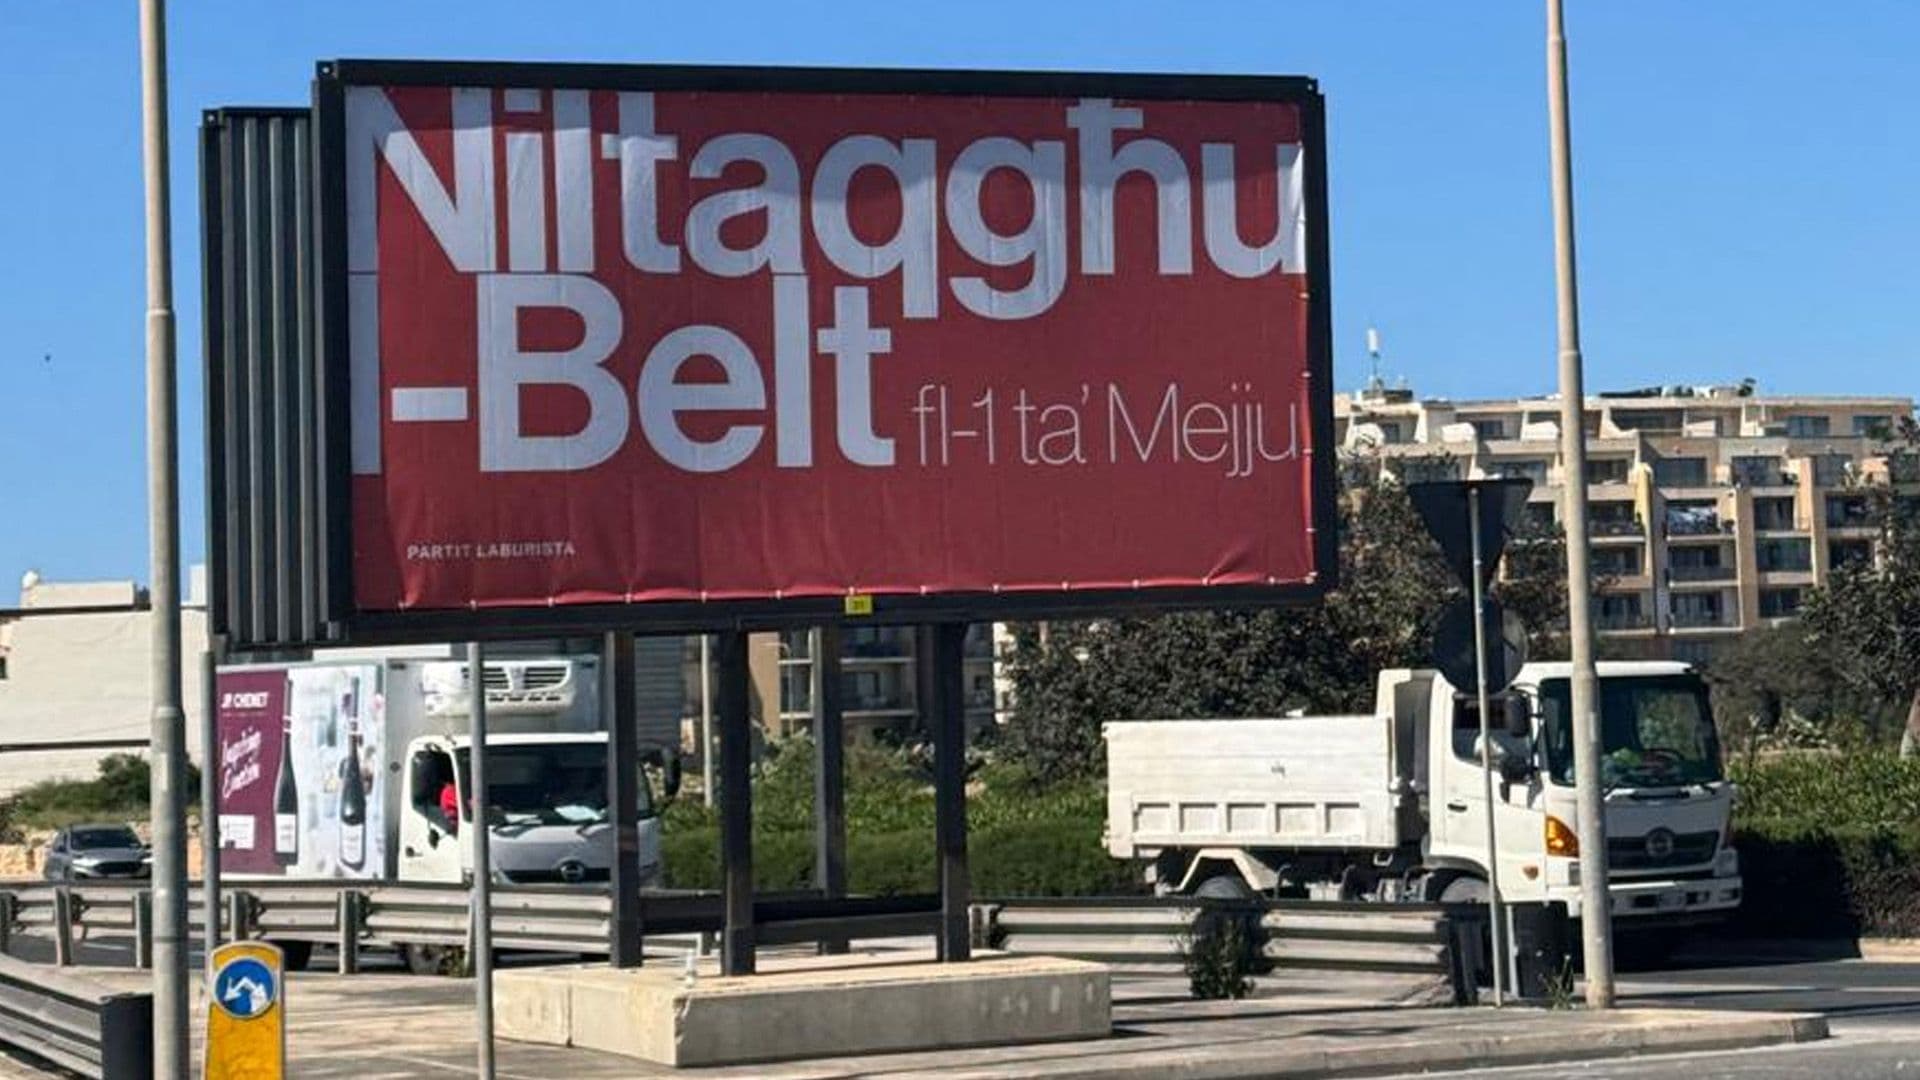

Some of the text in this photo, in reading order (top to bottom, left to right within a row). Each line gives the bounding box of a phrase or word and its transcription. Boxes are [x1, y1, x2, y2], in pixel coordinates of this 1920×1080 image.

[344, 86, 1308, 320] Niltaqgħu
[912, 384, 996, 466] fl-1
[1012, 384, 1088, 466] ta'
[1108, 382, 1298, 478] Mejju
[406, 540, 577, 561] PARTIT LABURISTA
